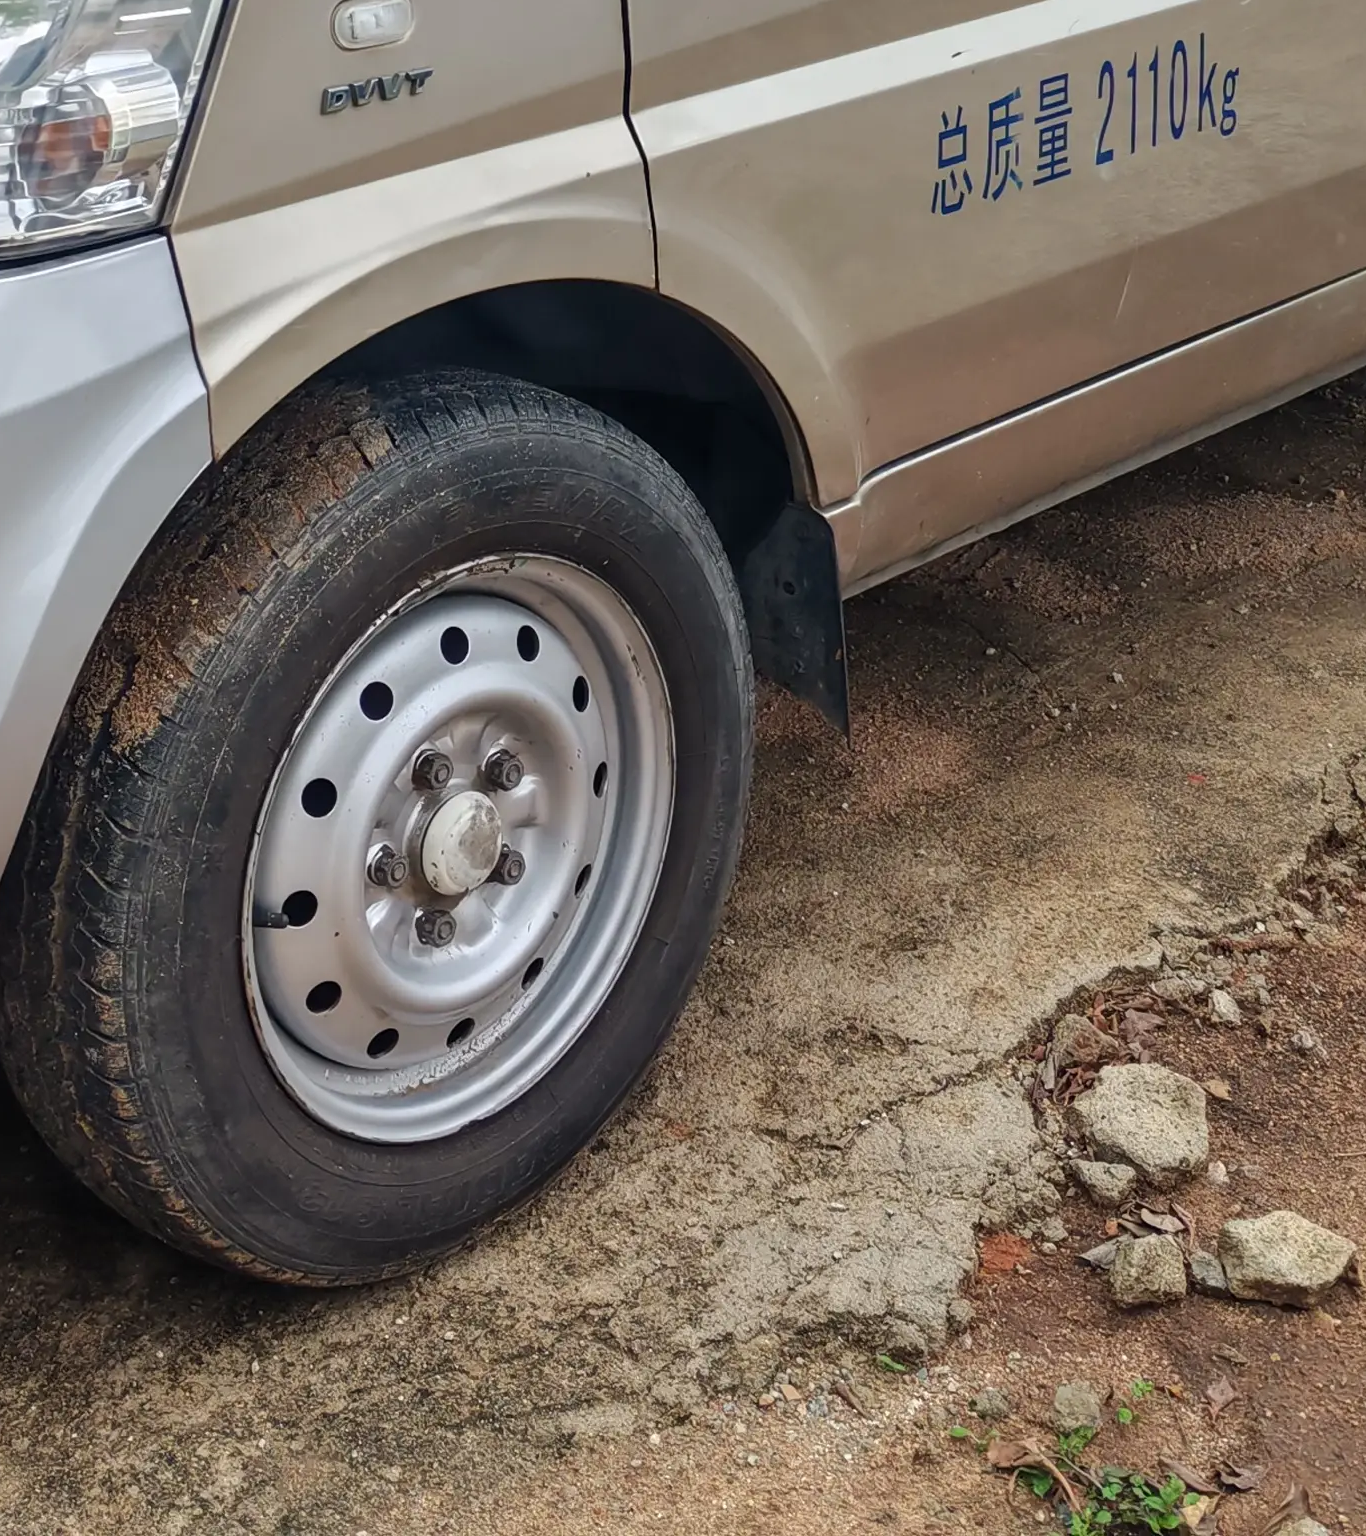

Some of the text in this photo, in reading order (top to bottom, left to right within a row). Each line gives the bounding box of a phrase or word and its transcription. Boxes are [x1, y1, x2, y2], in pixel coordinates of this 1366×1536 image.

[320, 66, 434, 115] DVVT
[931, 32, 1240, 215] 总质量 2110kg
